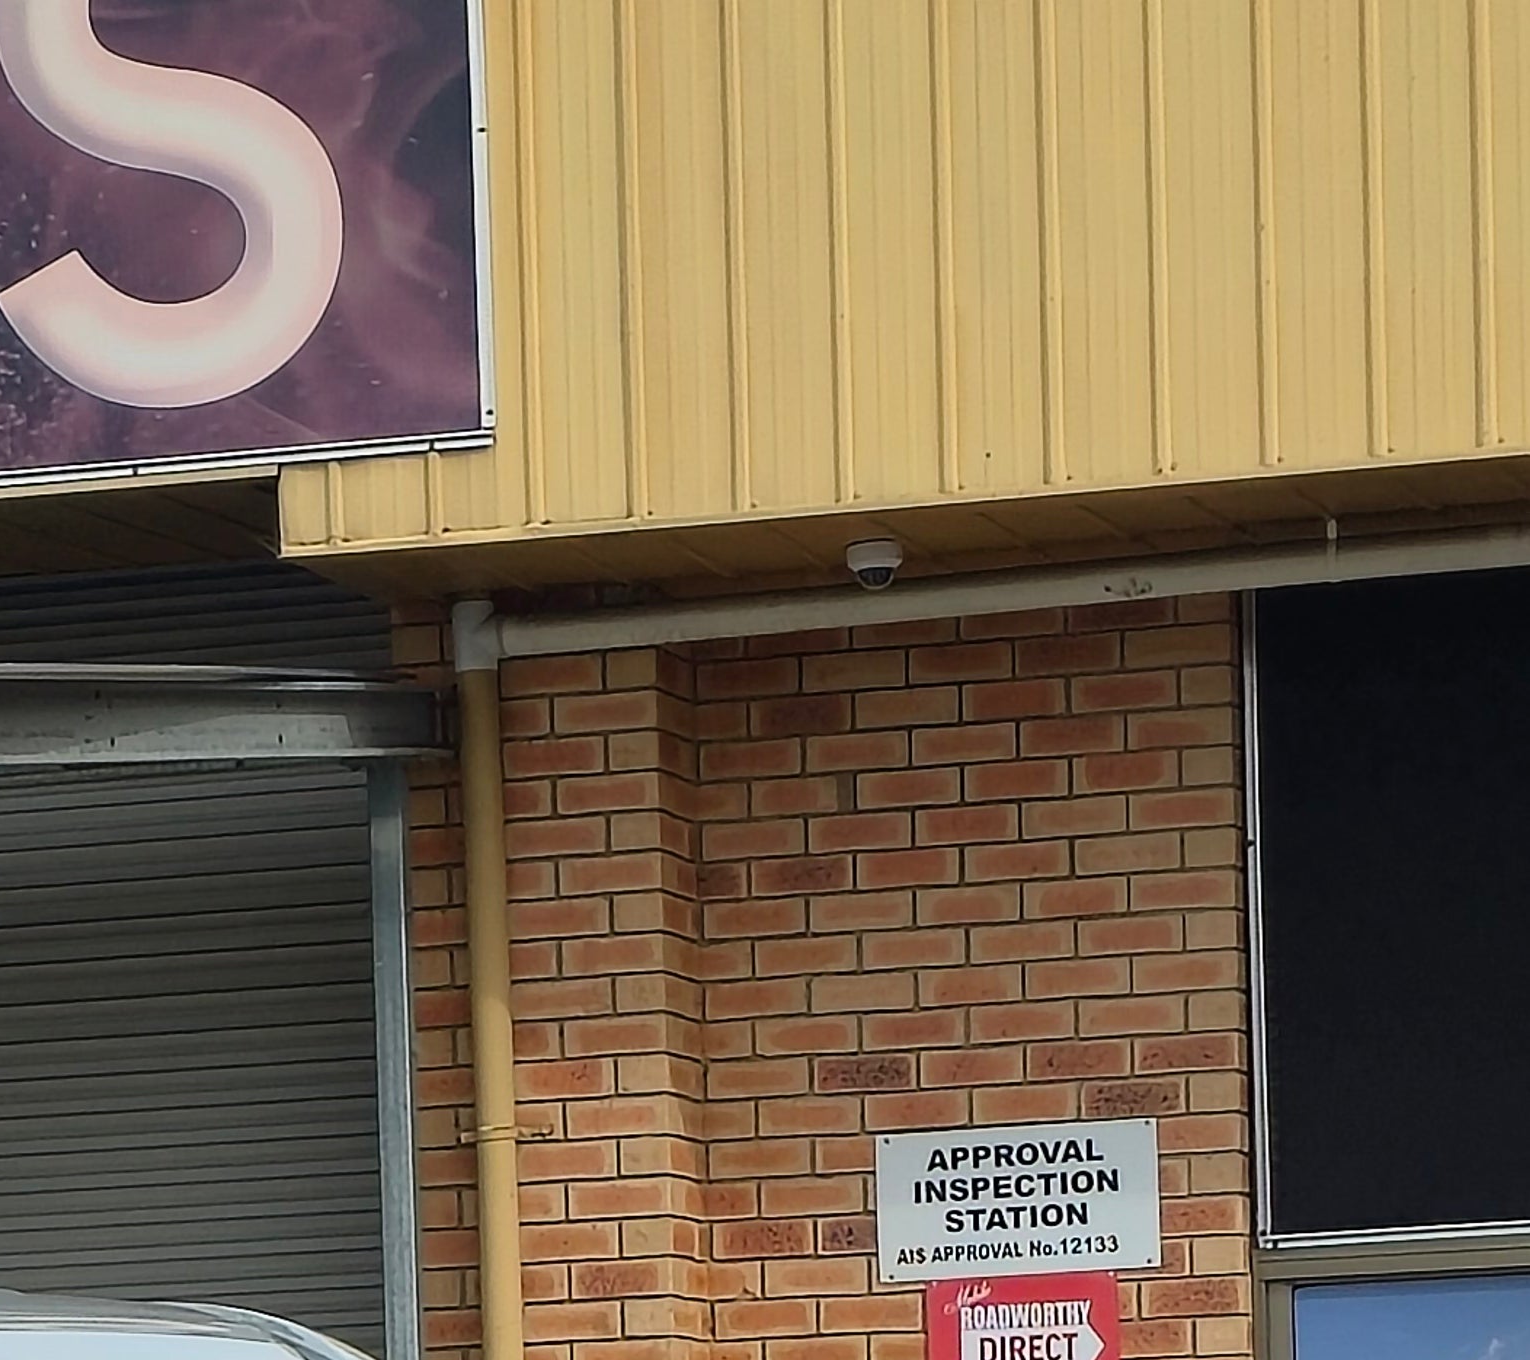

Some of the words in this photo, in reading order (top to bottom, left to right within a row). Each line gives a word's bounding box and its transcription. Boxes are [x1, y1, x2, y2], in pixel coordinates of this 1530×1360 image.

[927, 1138, 1104, 1171] APPROVAL
[914, 1168, 1119, 1204] INSPECTION
[945, 1202, 1088, 1232] STATION
[897, 1248, 927, 1265] AIS
[931, 1241, 1023, 1263] APPROVAL
[960, 1300, 1091, 1330] ROADWORTHY
